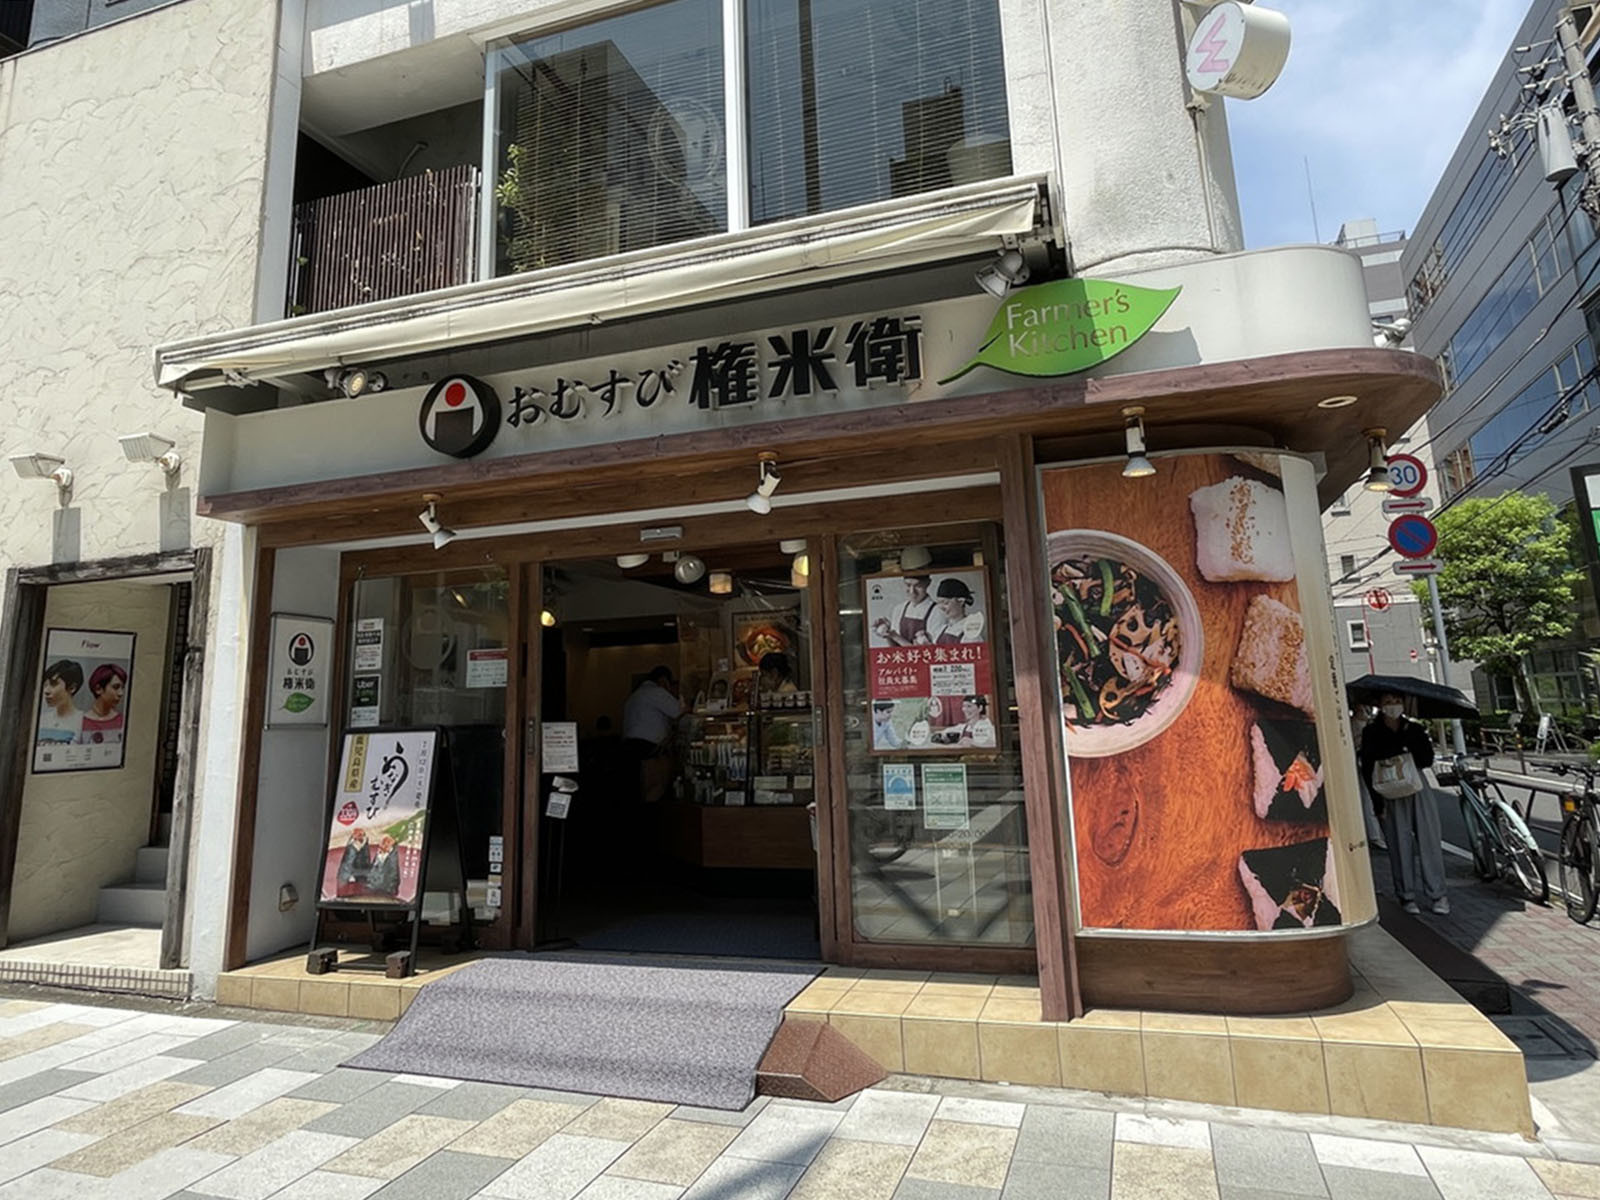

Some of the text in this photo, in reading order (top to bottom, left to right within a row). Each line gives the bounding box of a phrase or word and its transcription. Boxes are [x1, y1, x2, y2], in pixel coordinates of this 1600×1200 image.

[1006, 288, 1130, 330] Farmer's
[1009, 324, 1128, 358] Kitchen
[1390, 465, 1417, 485] 30
